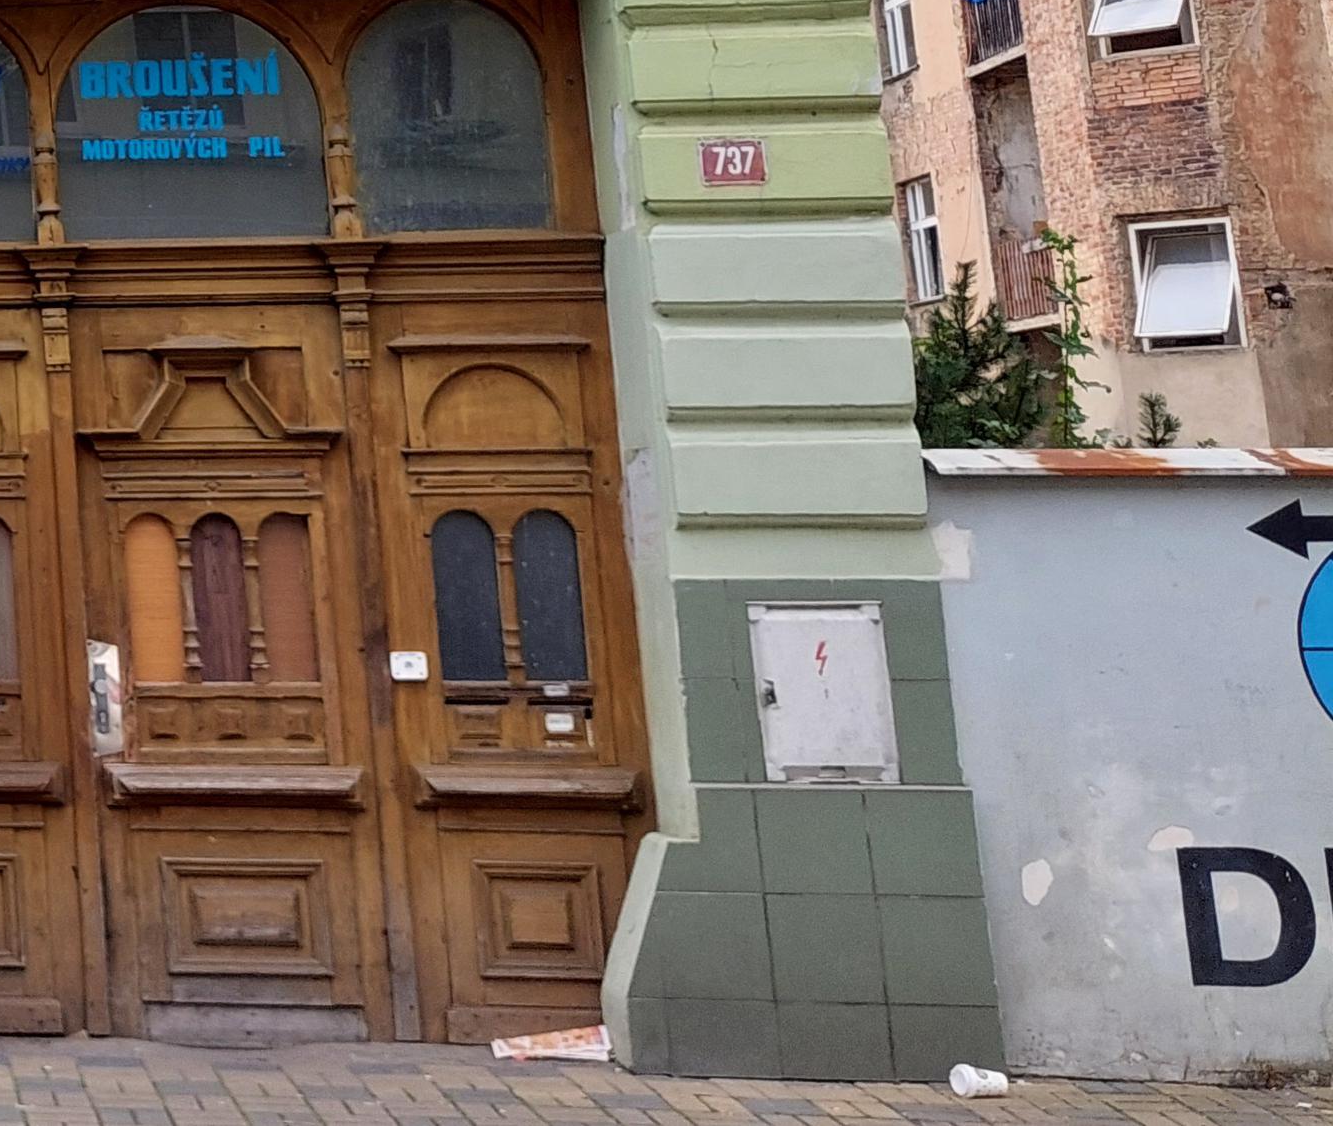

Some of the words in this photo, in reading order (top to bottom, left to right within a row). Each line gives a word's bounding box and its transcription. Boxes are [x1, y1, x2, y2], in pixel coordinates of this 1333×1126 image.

[79, 48, 281, 99] BROUŠENÍ
[138, 105, 225, 132] ŘETĚZŮ
[82, 132, 228, 161] MOTOROVÝCH
[248, 135, 285, 158] PIL
[711, 145, 755, 176] 737
[1176, 847, 1333, 988] D
